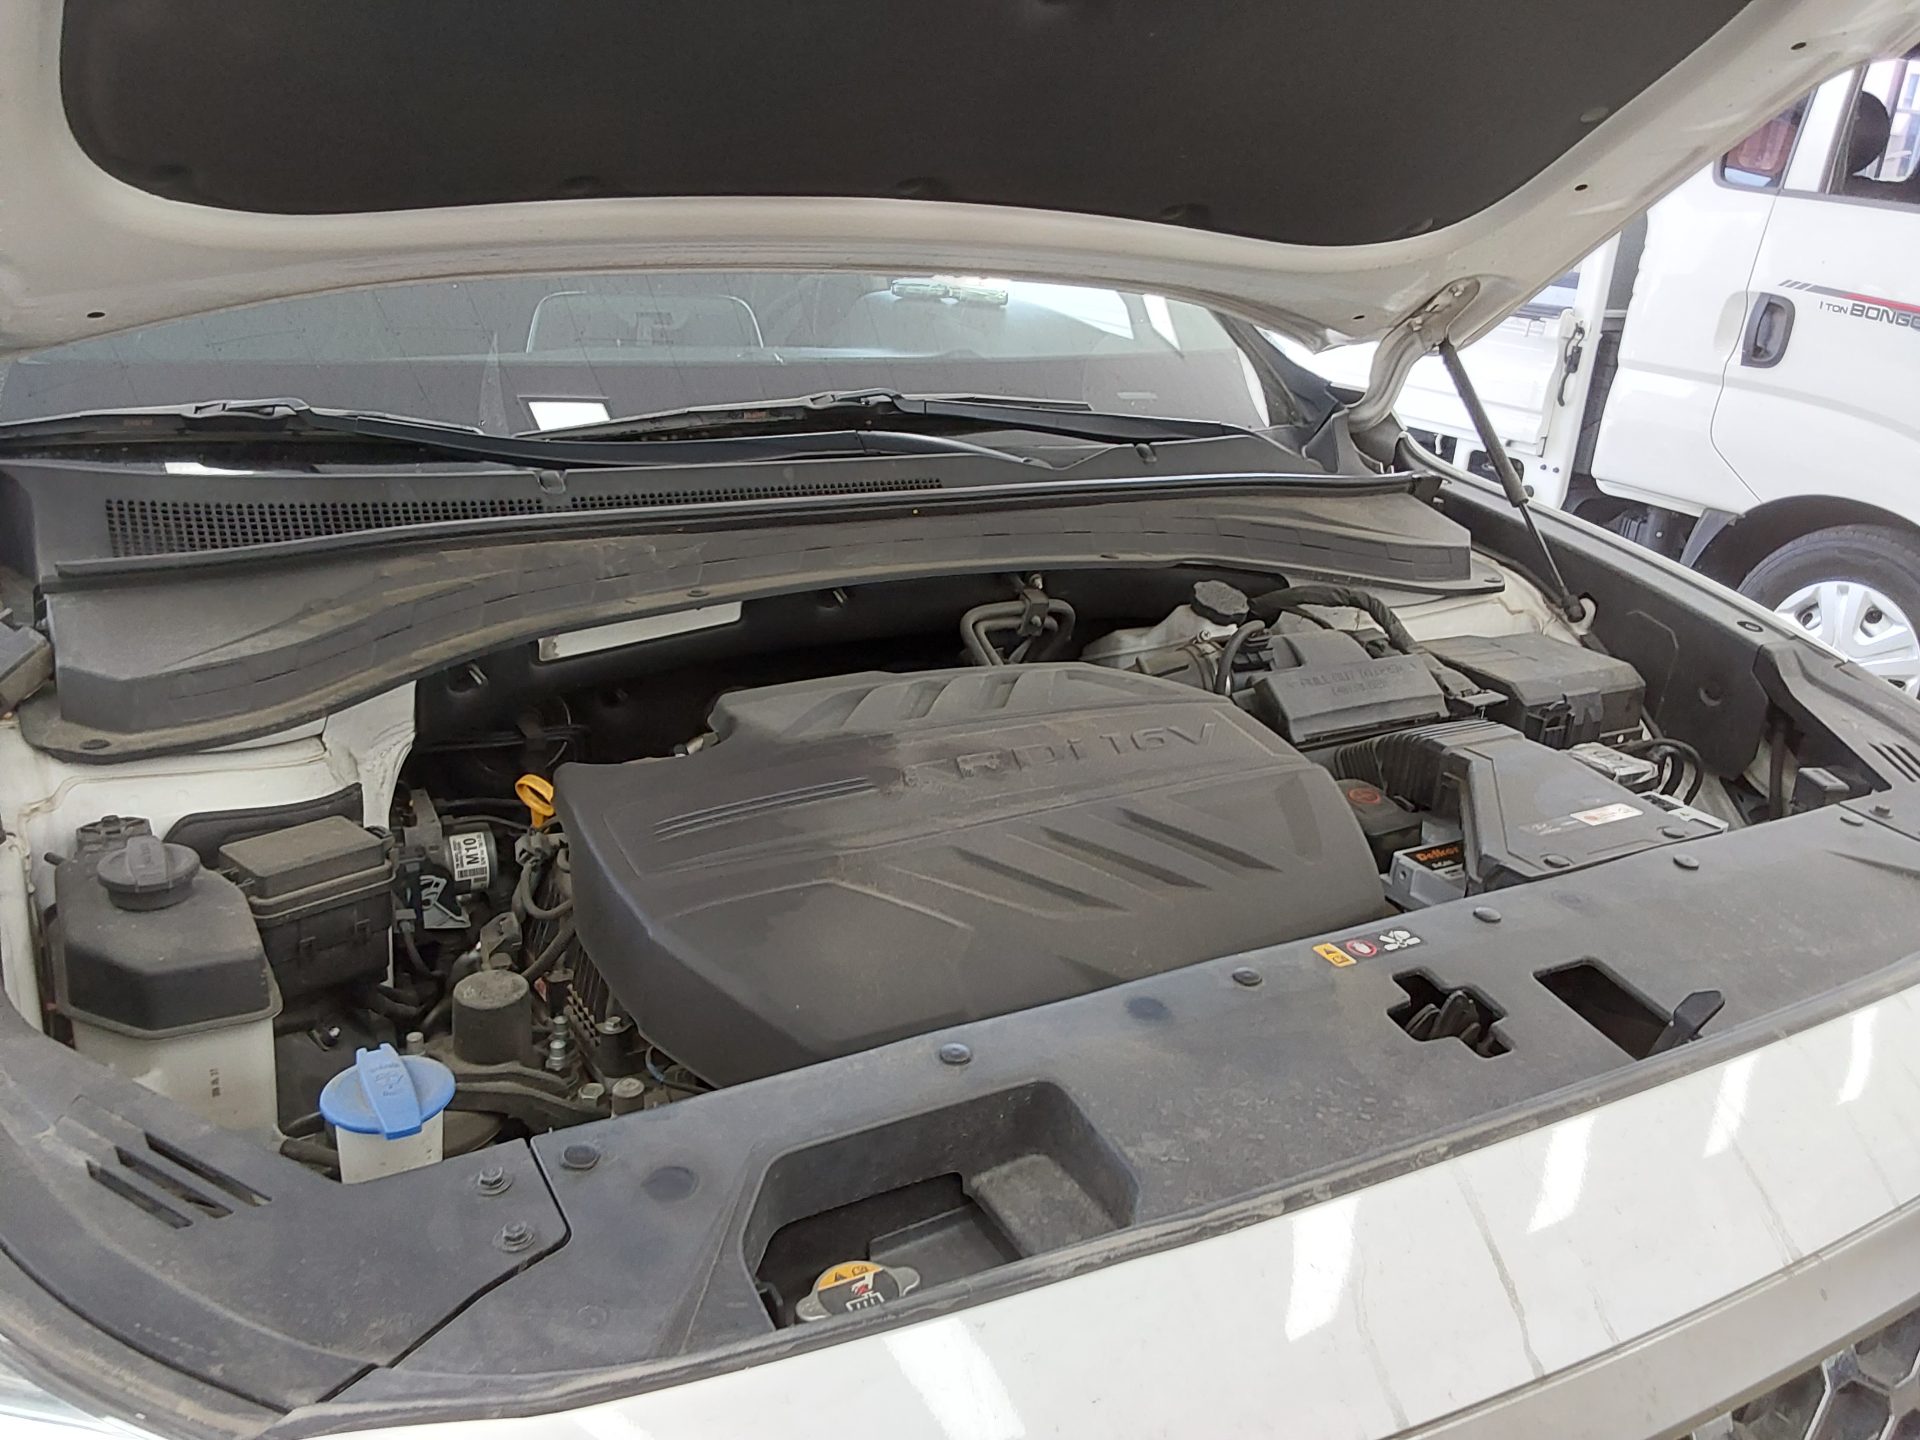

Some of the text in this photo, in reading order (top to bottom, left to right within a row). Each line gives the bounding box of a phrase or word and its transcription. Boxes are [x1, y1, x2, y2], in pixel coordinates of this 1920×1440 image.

[1825, 303, 1848, 314] TON
[1099, 722, 1216, 756] 16V
[463, 838, 480, 865] M10
